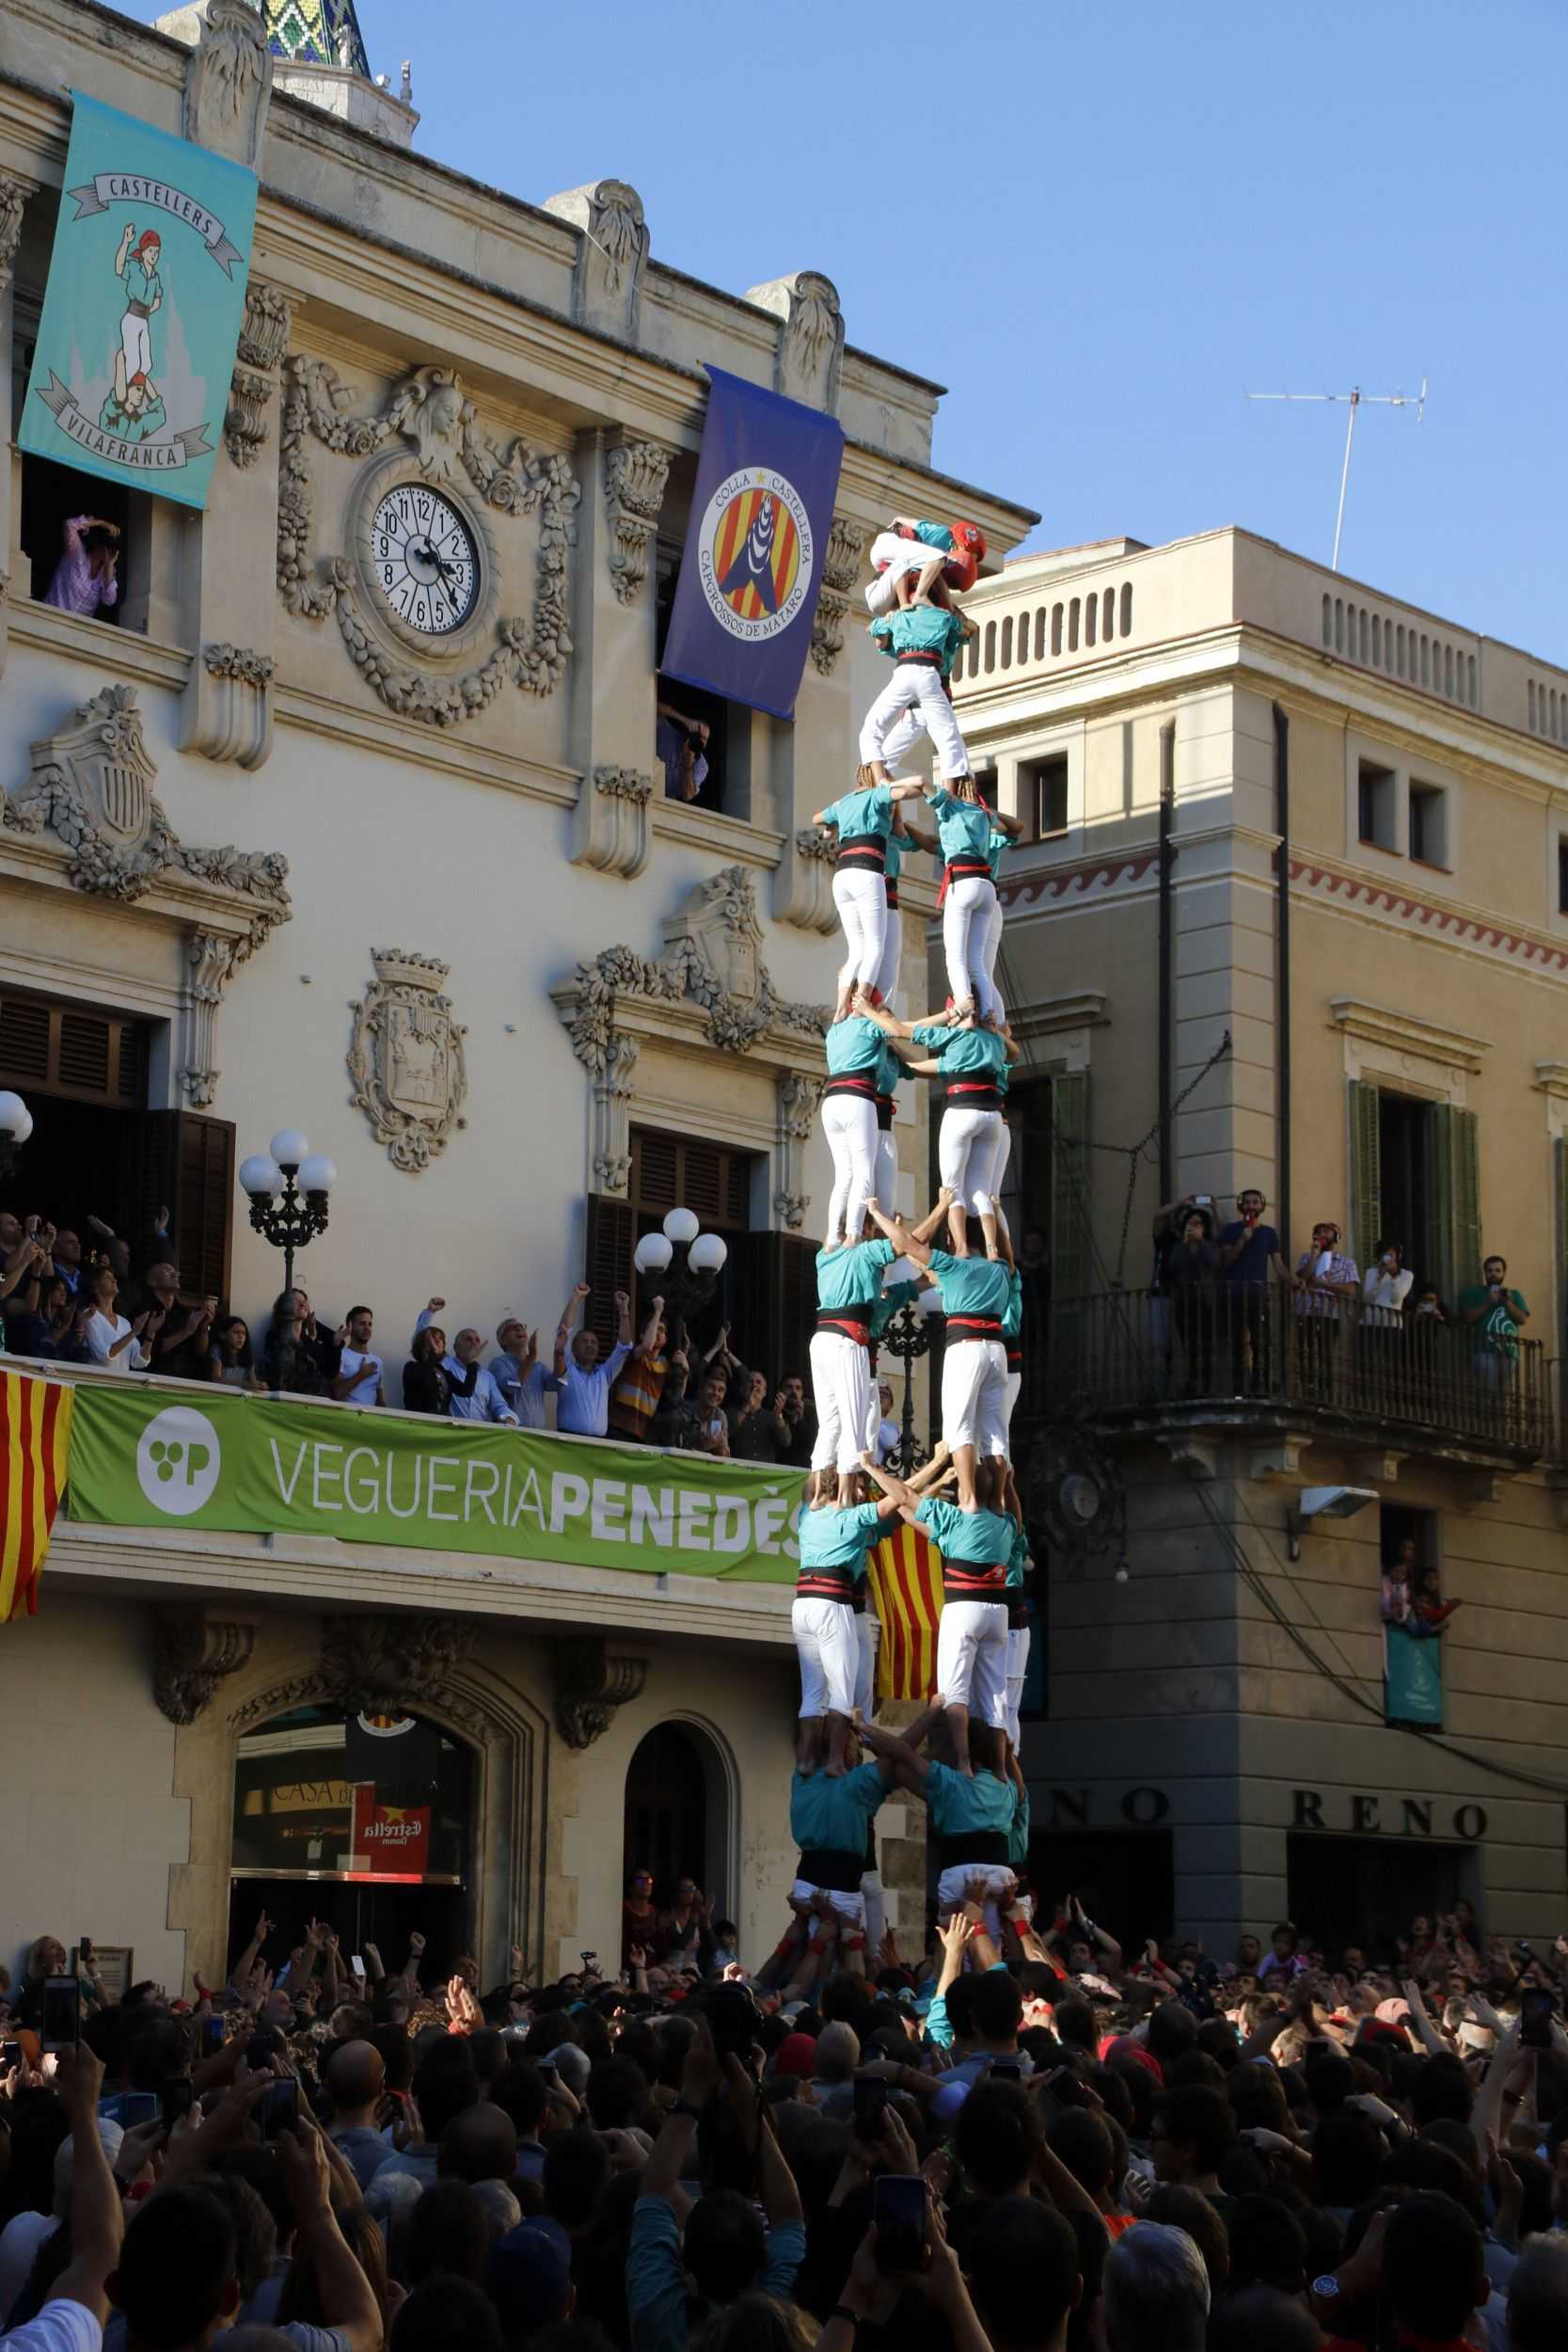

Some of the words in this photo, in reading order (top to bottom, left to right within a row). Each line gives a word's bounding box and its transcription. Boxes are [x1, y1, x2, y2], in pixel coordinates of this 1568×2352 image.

[109, 177, 214, 235] CASTELLERS
[67, 412, 178, 467] VILAFRANCA
[399, 498, 408, 520] 11
[417, 499, 430, 521] 12
[715, 473, 751, 507] COLLA
[771, 477, 811, 564] CASTELLERA
[385, 512, 397, 534] 10
[438, 514, 445, 533] 1
[380, 536, 388, 557] 9
[451, 535, 460, 556] 2
[385, 564, 393, 584] 8
[455, 564, 464, 584] 3
[400, 589, 408, 611] 7
[701, 550, 744, 634] CAPGROSSOS
[745, 624, 761, 637] DE
[417, 600, 425, 622] 6
[436, 601, 444, 623] 5
[270, 1437, 546, 1532] VEGUERIA
[1291, 1788, 1490, 1840] RENO
